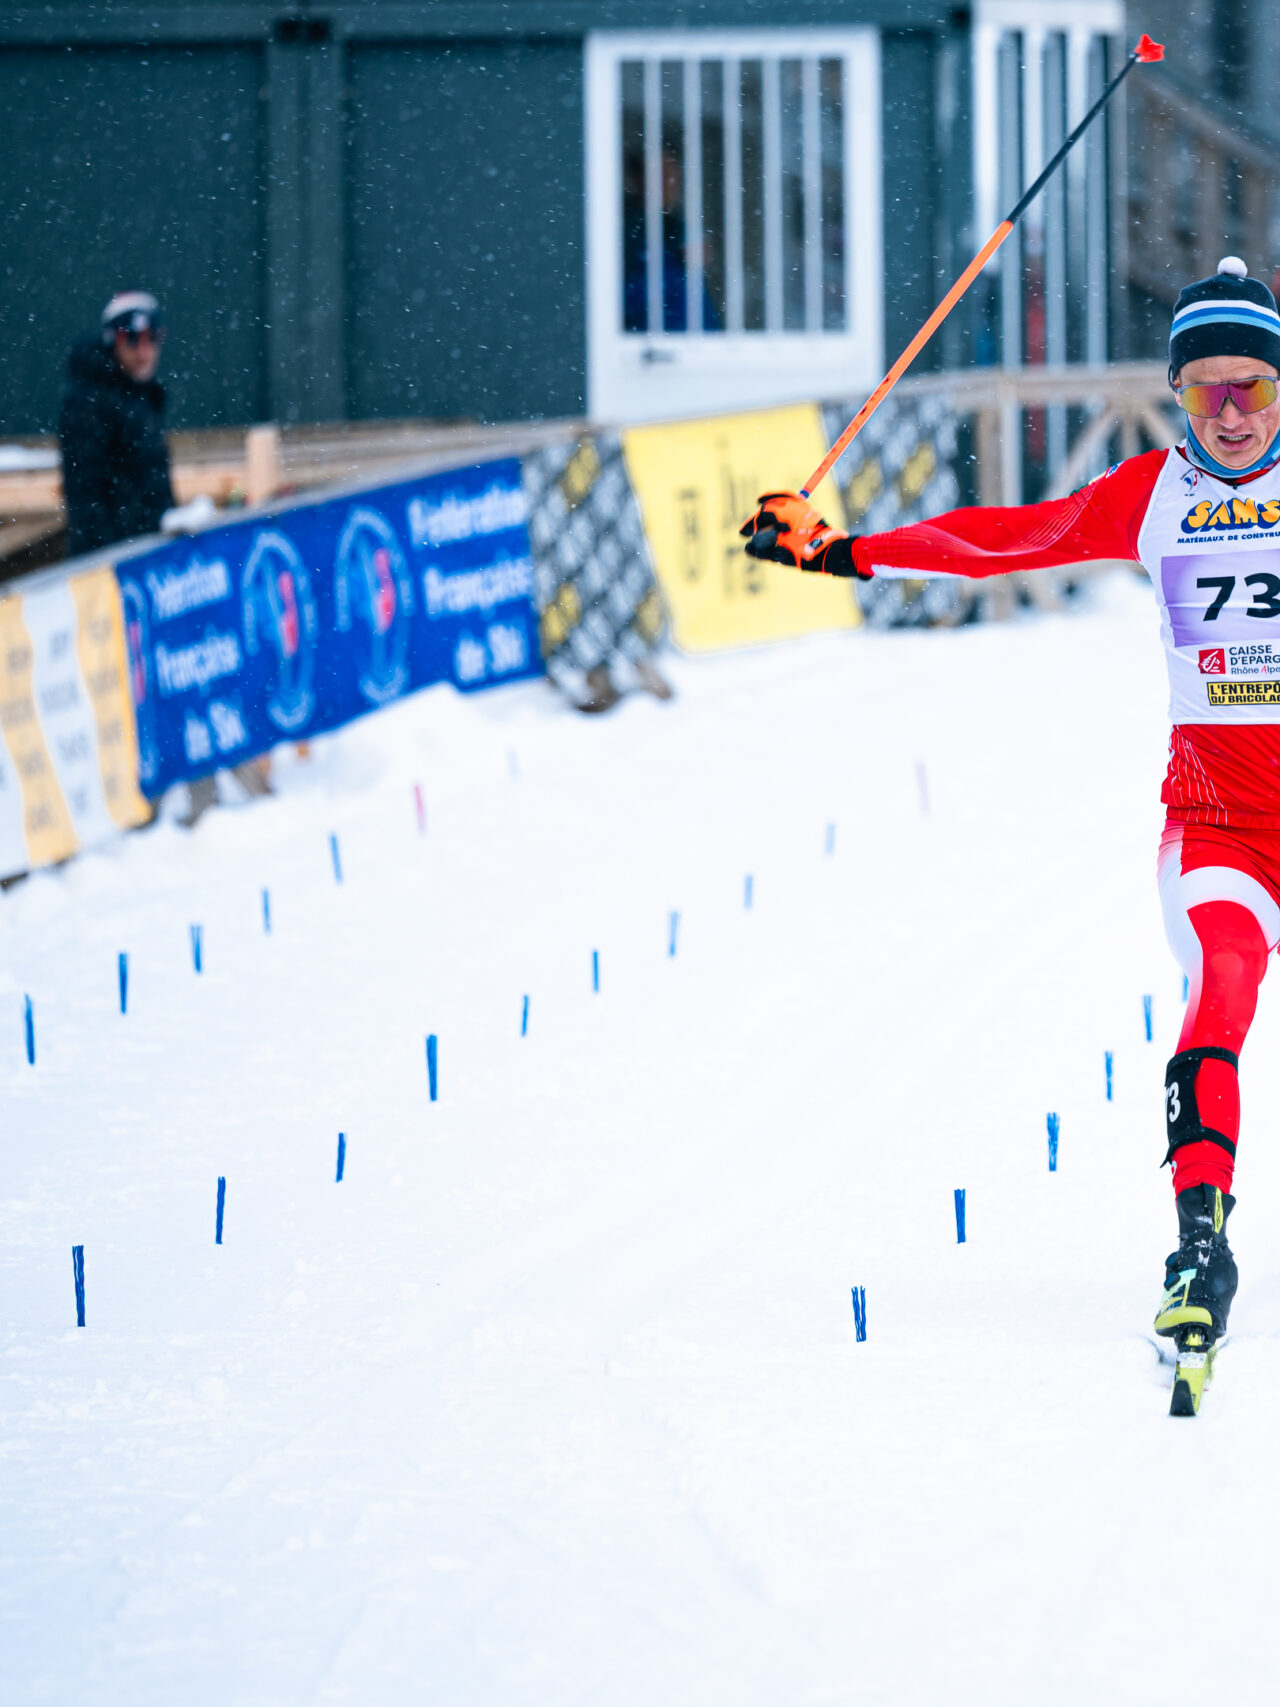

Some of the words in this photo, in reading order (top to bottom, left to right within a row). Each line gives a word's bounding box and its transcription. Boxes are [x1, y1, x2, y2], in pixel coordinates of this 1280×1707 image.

[1177, 534, 1225, 543] MATÉRIAUX
[1229, 645, 1273, 656] CAISSE
[1231, 666, 1259, 675] Rhône
[1211, 695, 1225, 703] DU
[1165, 1081, 1181, 1123] 3
